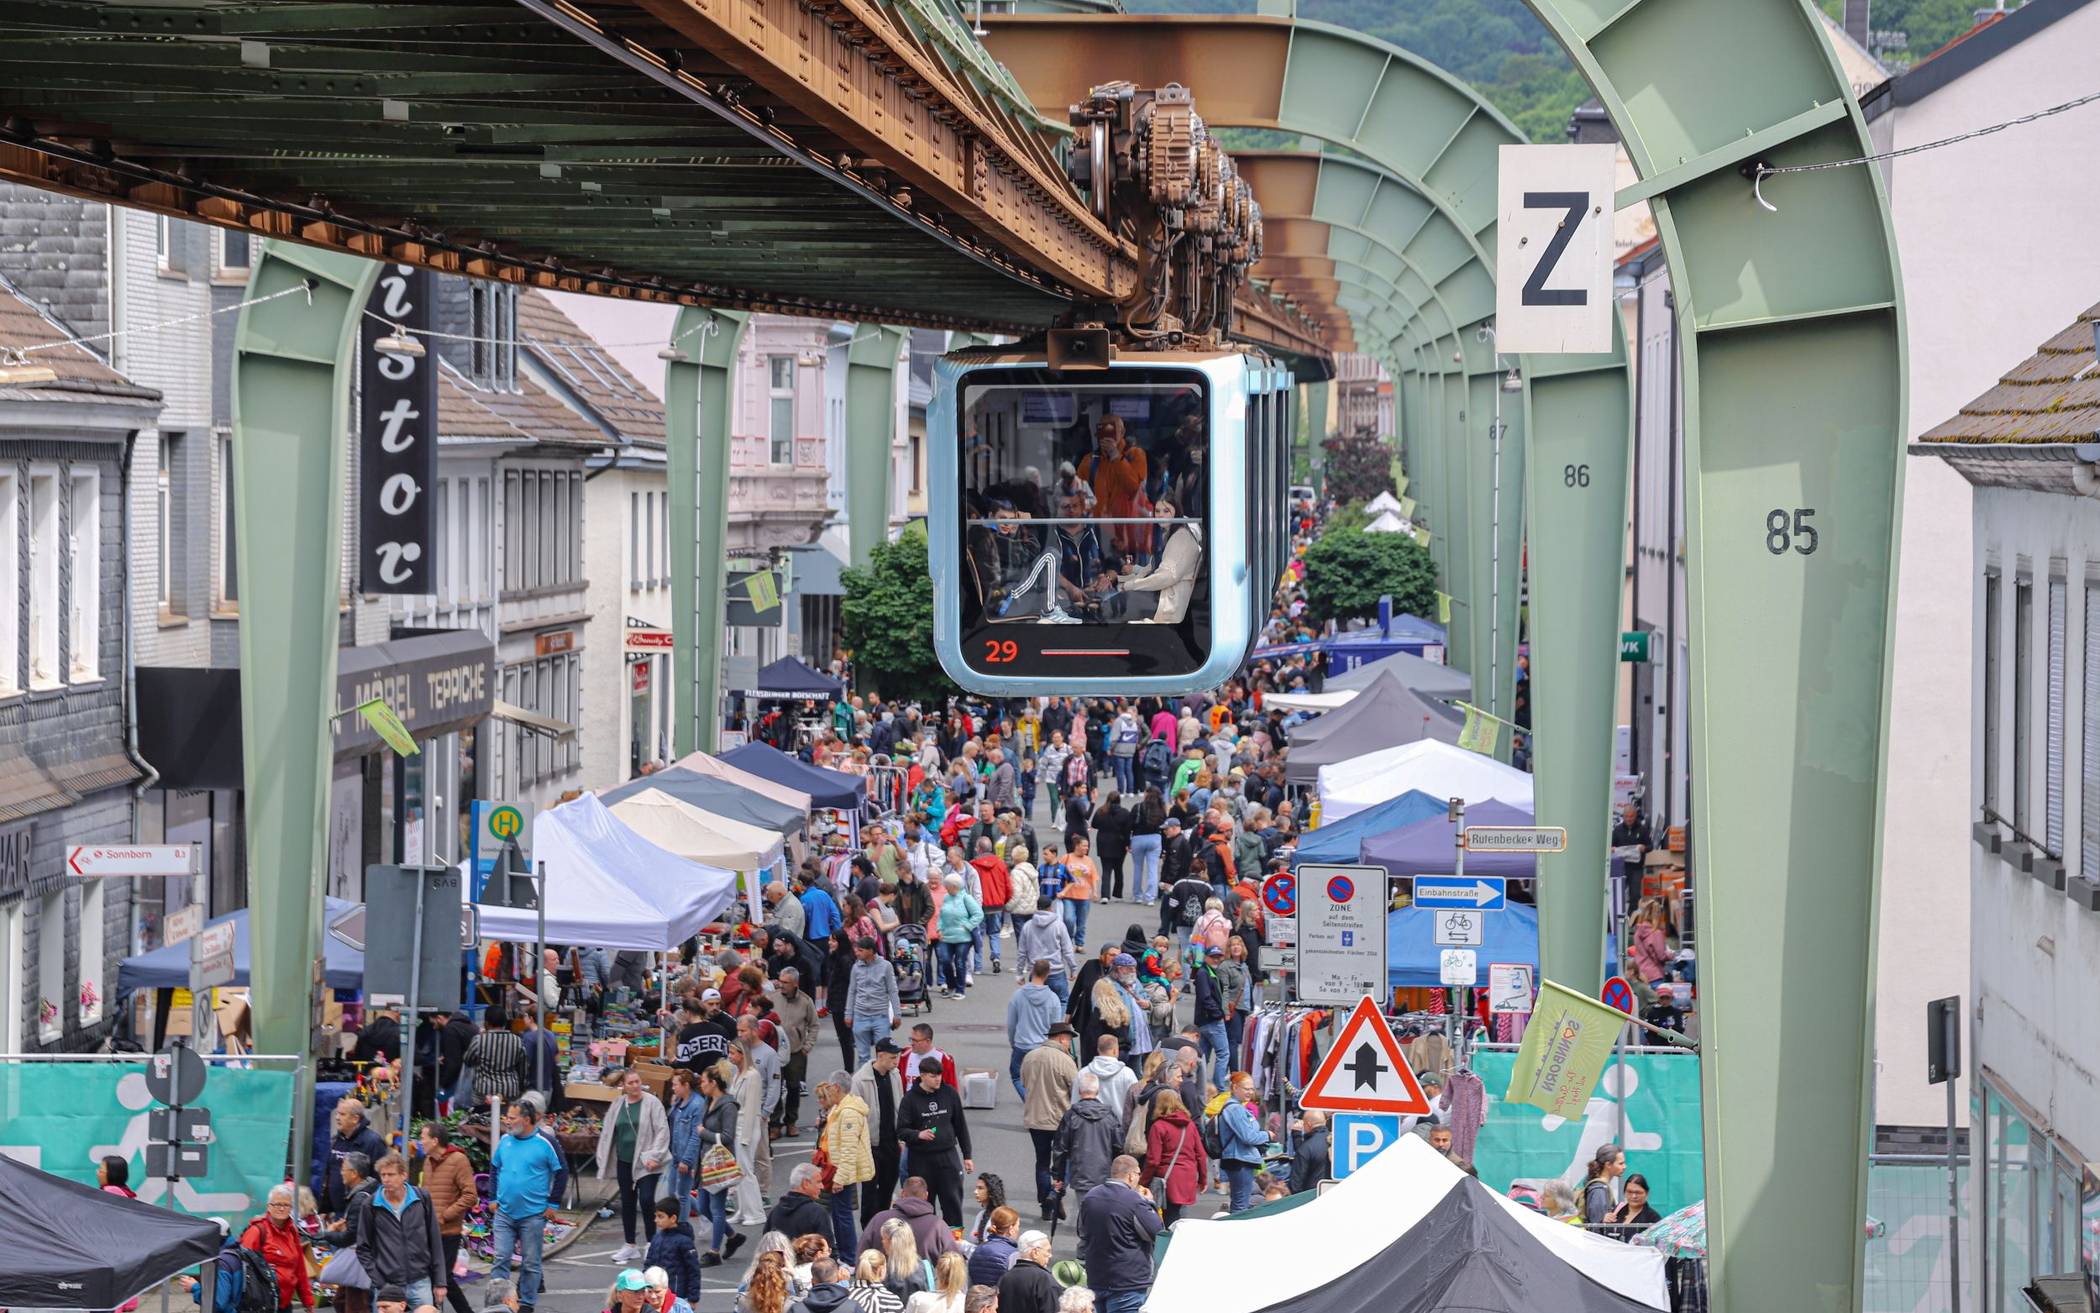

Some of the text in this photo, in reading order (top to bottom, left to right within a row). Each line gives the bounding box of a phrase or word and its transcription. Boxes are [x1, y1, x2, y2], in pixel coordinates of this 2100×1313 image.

[1522, 191, 1589, 306] Z
[1489, 425, 1508, 440] 87
[1564, 464, 1590, 488] 86
[1766, 508, 1818, 555] 85
[985, 640, 1018, 662] 29
[427, 662, 485, 710] TEPPICHE
[1472, 833, 1558, 846] Rutenbecker Weg
[106, 850, 152, 859] Sonnborn
[1419, 888, 1479, 898] Einbahnstraße
[1348, 1122, 1384, 1172] P
